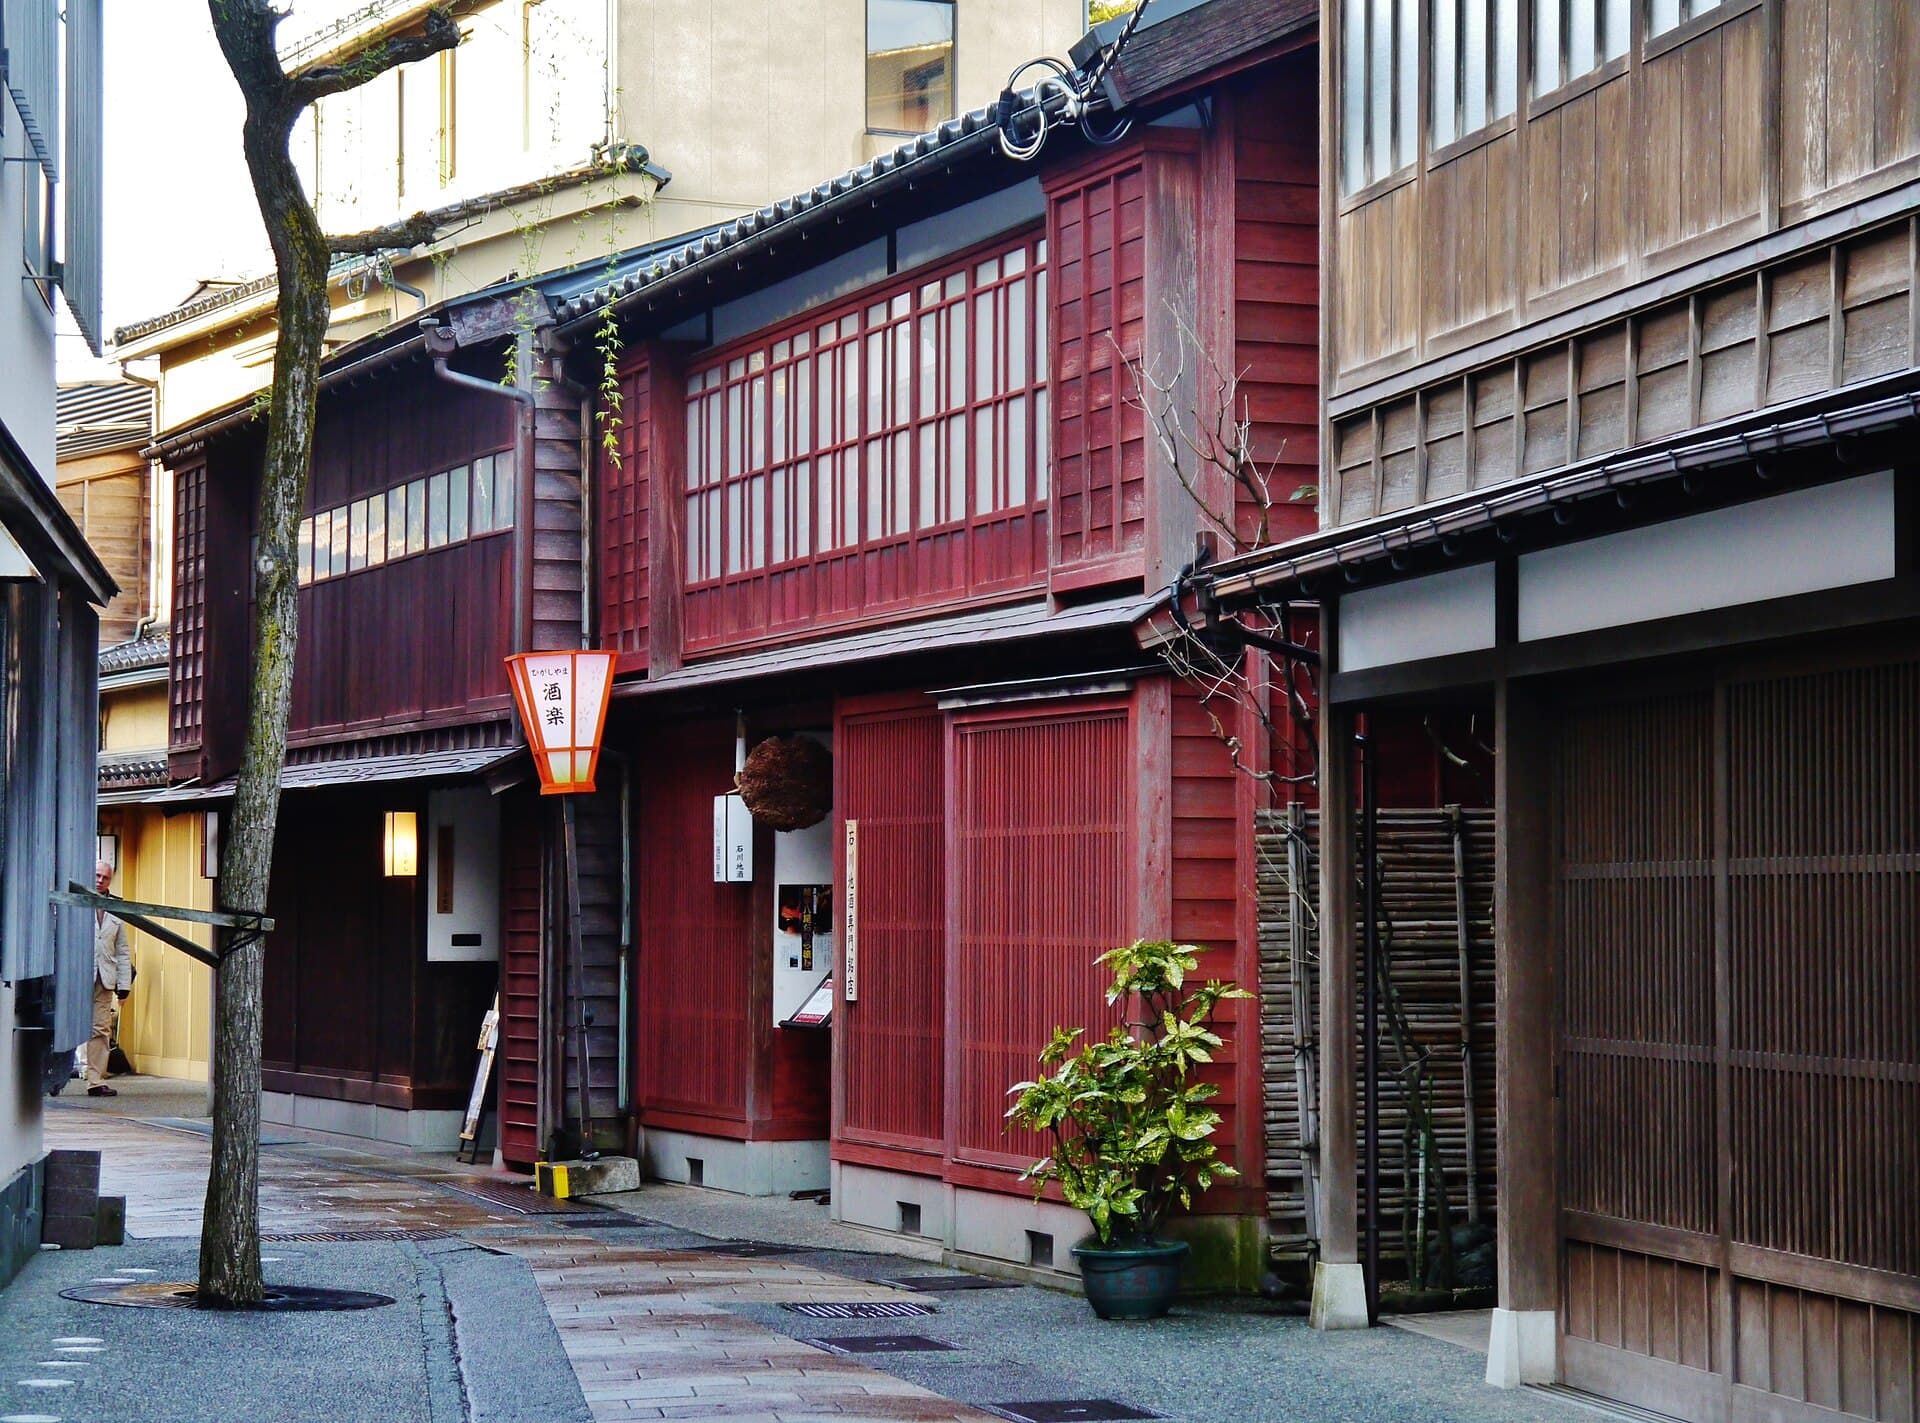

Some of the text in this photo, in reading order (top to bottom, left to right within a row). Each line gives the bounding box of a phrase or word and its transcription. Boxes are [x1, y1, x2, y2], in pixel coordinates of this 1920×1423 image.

[532, 668, 569, 677] ひがしやま
[542, 682, 564, 726] 酒楽
[736, 845, 744, 878] 石川地酒
